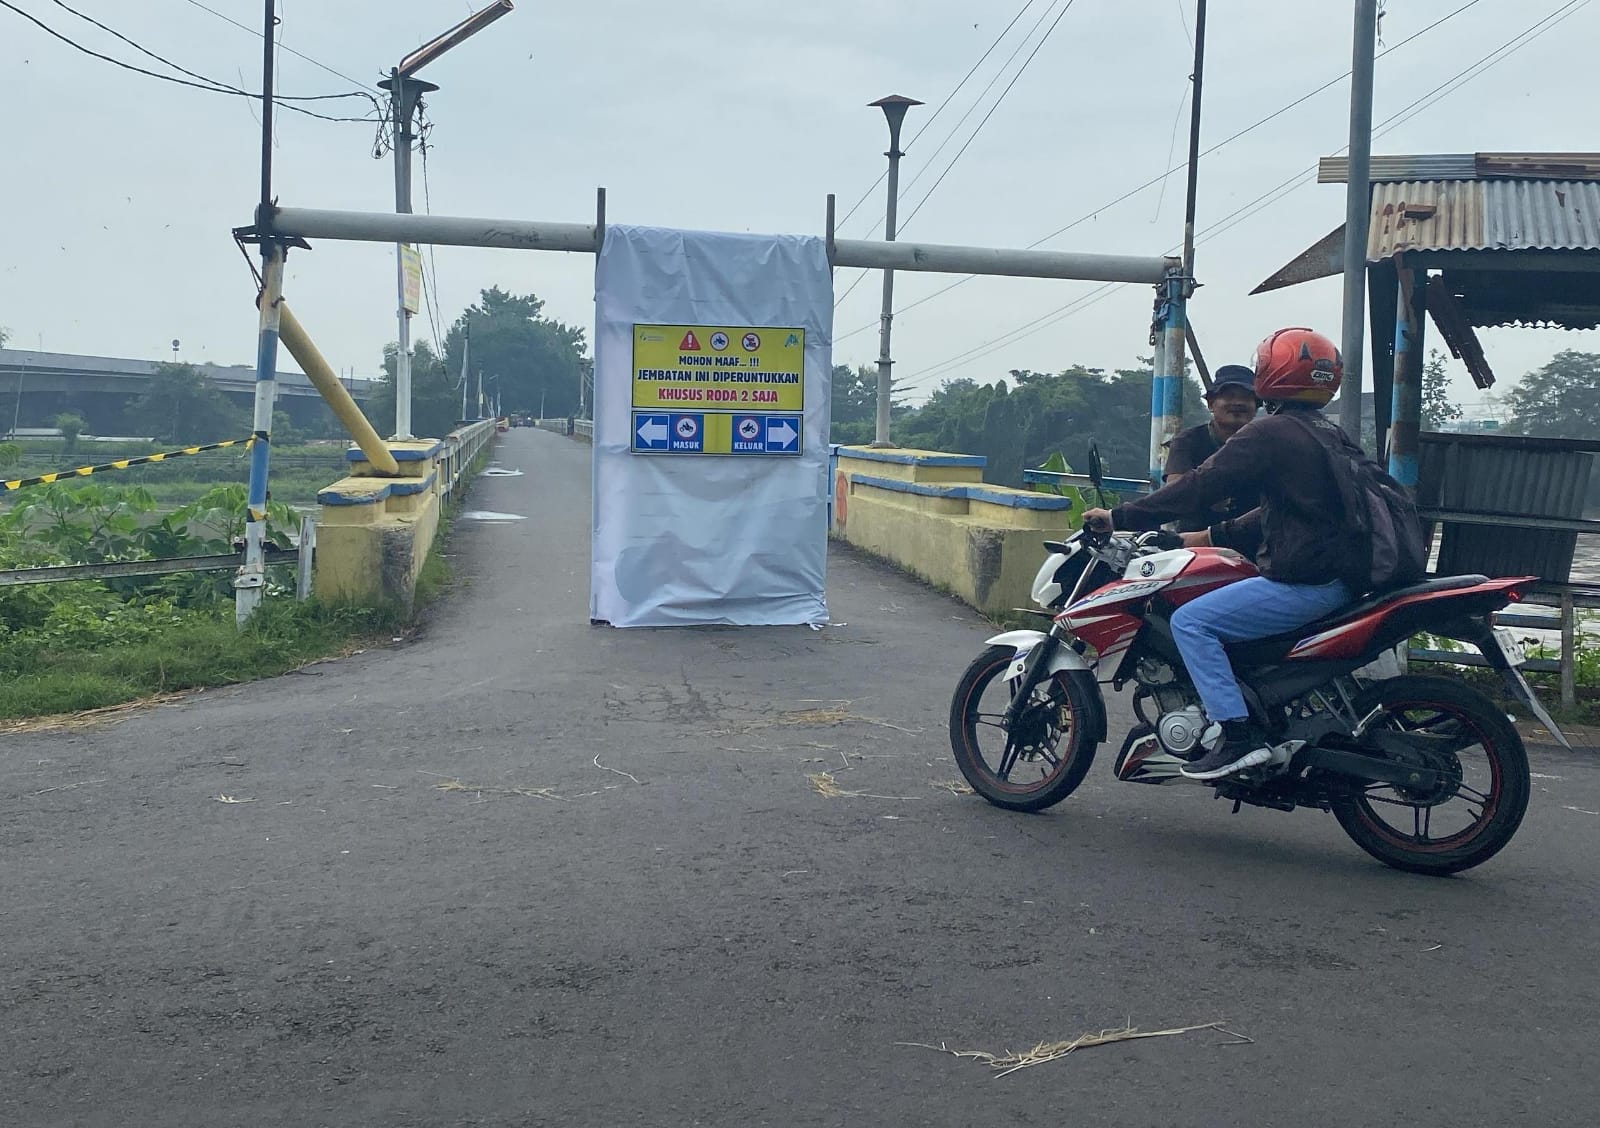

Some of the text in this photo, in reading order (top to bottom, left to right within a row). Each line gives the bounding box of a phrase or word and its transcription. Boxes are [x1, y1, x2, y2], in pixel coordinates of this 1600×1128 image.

[679, 356, 712, 366] MOHON
[750, 358, 759, 367] !!!
[637, 369, 799, 384] JEMBATAN INI DIPERUNTUKKAN
[658, 388, 778, 403] KHUSUS RODA 2 SAJA
[673, 441, 700, 449] MASUK
[734, 442, 764, 450] KELUAR
